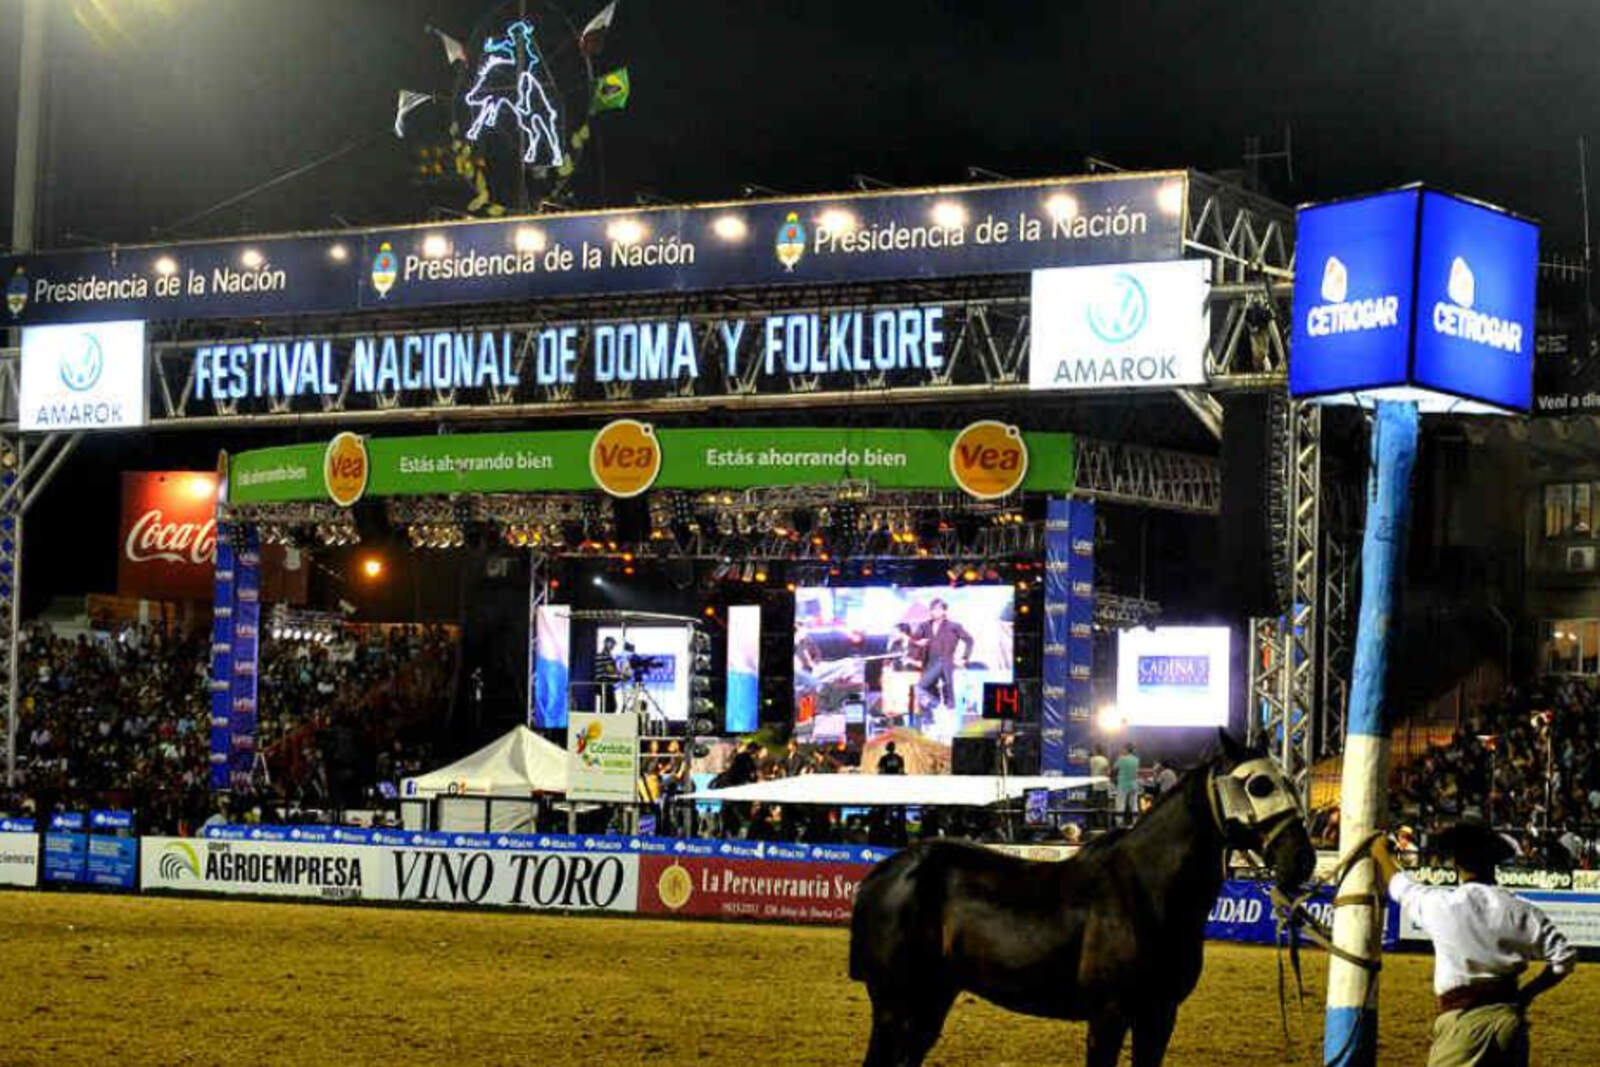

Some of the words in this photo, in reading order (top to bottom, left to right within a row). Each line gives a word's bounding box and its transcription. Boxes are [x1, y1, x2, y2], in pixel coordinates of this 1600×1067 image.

[814, 222, 963, 254] Presidencia
[975, 215, 1008, 244] de
[1019, 213, 1040, 241] la
[1052, 206, 1147, 239] Nación
[404, 249, 534, 281] Presidencia
[544, 243, 573, 272] de
[582, 241, 602, 269] la
[611, 235, 695, 266] Nación
[35, 274, 147, 303] Presidencia
[155, 271, 181, 297] de
[187, 269, 205, 294] la
[212, 264, 286, 293] Nación
[1307, 297, 1399, 336] CETROGAR
[1433, 302, 1523, 353] CETROGAR
[195, 339, 338, 400] FESTIVAL
[354, 331, 520, 392] NACIONAL
[537, 327, 579, 384] DE
[595, 320, 699, 382] DOMA
[719, 319, 746, 377] Y
[764, 305, 945, 375] FOLKLORE
[1053, 356, 1176, 383] AMAROK
[35, 402, 123, 426] AMAROK
[331, 453, 363, 479] Vea
[400, 455, 434, 472] Estás
[437, 453, 513, 471] ahorrando
[516, 450, 553, 469] bien
[599, 442, 653, 469] Vea
[706, 448, 753, 466] Estás
[758, 447, 859, 466] ahorrando
[864, 448, 907, 466] bien
[961, 444, 1019, 470] Vea
[994, 686, 1019, 714] 14
[205, 851, 363, 887] AGROEMPRESA
[393, 850, 494, 903] VINO
[509, 854, 624, 908] TORO
[702, 868, 719, 893] La
[723, 869, 830, 898] Perseverancia
